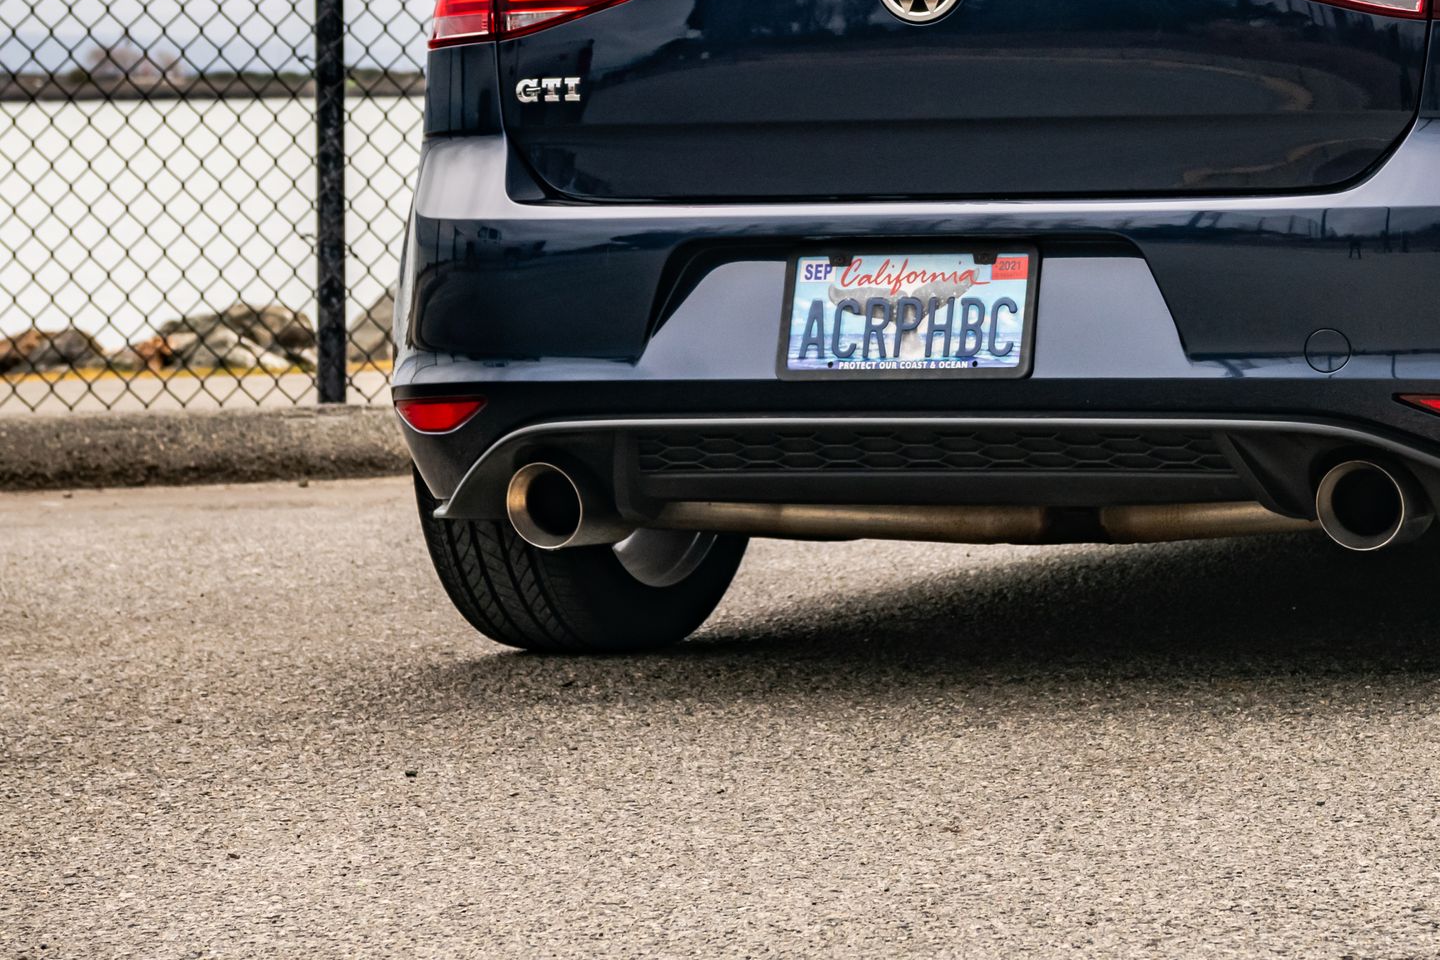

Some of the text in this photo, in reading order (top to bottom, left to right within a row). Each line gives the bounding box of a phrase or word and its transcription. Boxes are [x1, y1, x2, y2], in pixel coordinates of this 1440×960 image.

[515, 76, 581, 103] GTI
[804, 263, 833, 281] SEP
[840, 257, 991, 296] California
[998, 260, 1021, 271] 2021
[799, 296, 1018, 359] ACRPHBC
[838, 360, 968, 370] PROTECT OUR COAST & OCEAN
